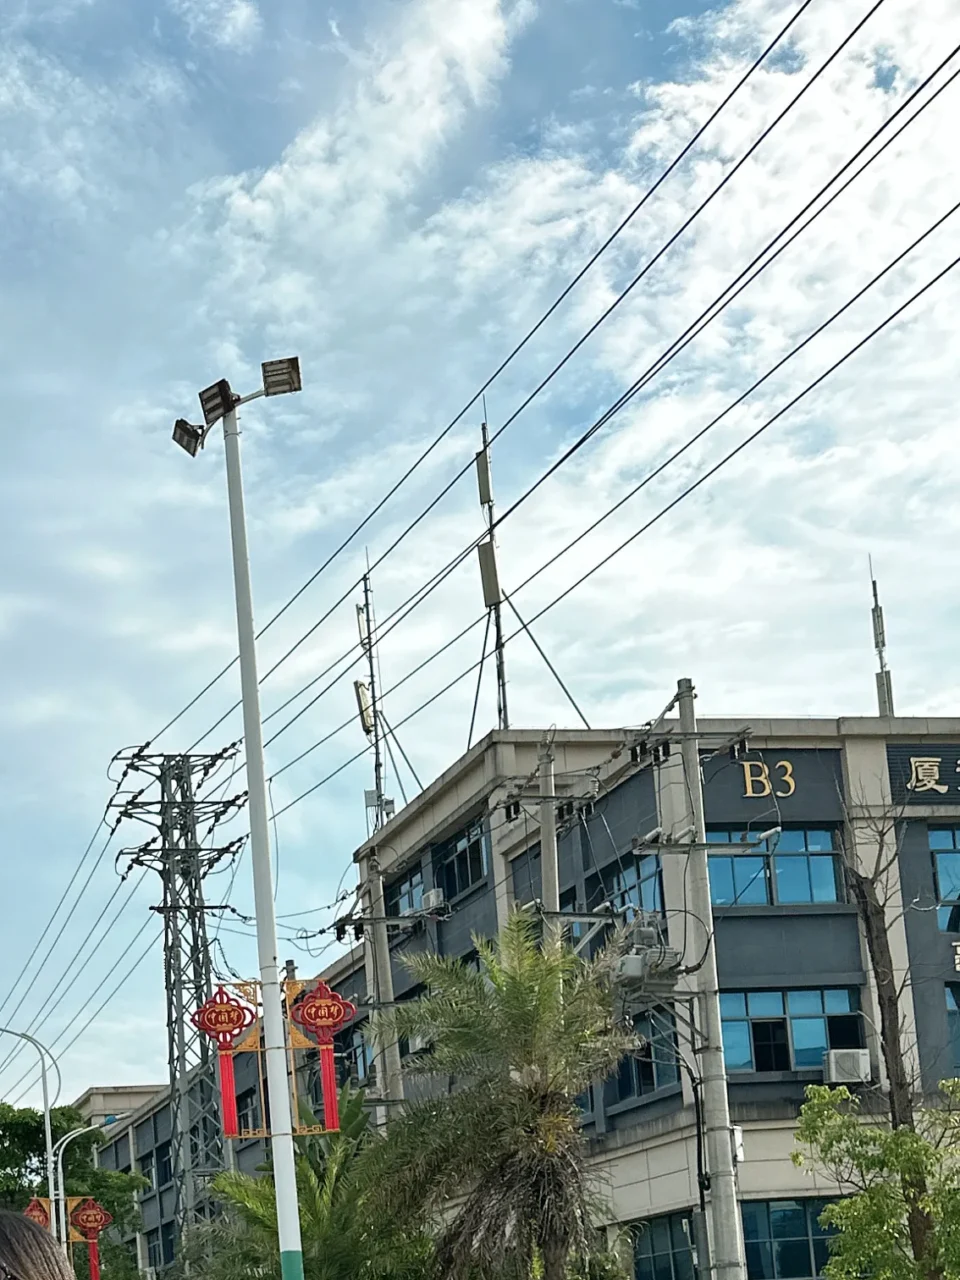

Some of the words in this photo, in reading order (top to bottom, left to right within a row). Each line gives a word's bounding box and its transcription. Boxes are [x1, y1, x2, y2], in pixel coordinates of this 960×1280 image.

[742, 760, 796, 798] B3
[906, 757, 960, 794] 厦
[207, 1011, 239, 1024] 中国梦
[308, 1005, 339, 1019] 中国梦
